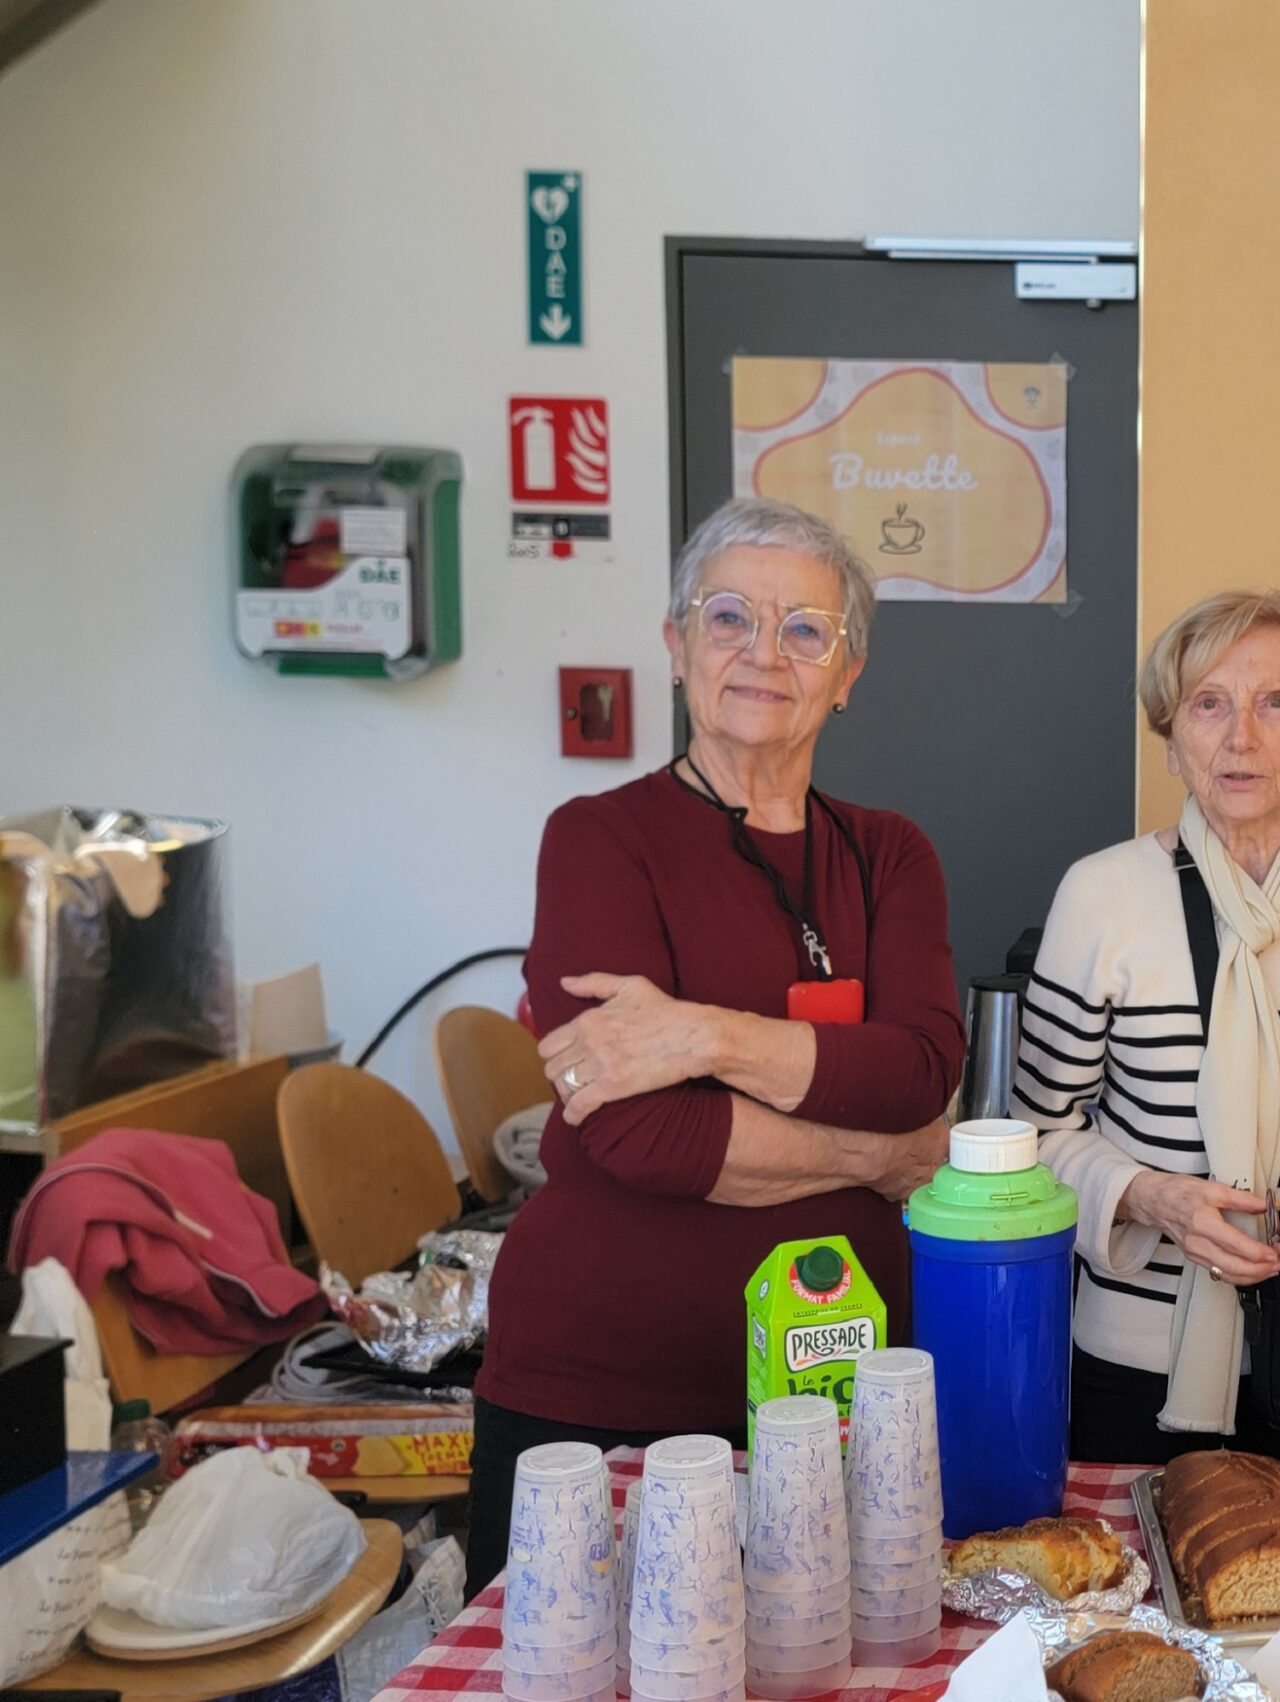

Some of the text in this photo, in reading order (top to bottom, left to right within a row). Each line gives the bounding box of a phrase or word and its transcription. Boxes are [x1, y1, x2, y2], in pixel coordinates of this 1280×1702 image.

[544, 226, 567, 299] DAE
[829, 451, 978, 491] Buvette
[791, 1268, 852, 1304] FORMAT FAMILIAL
[792, 1323, 867, 1361] PRESSADE
[412, 1432, 470, 1454] MAXI
